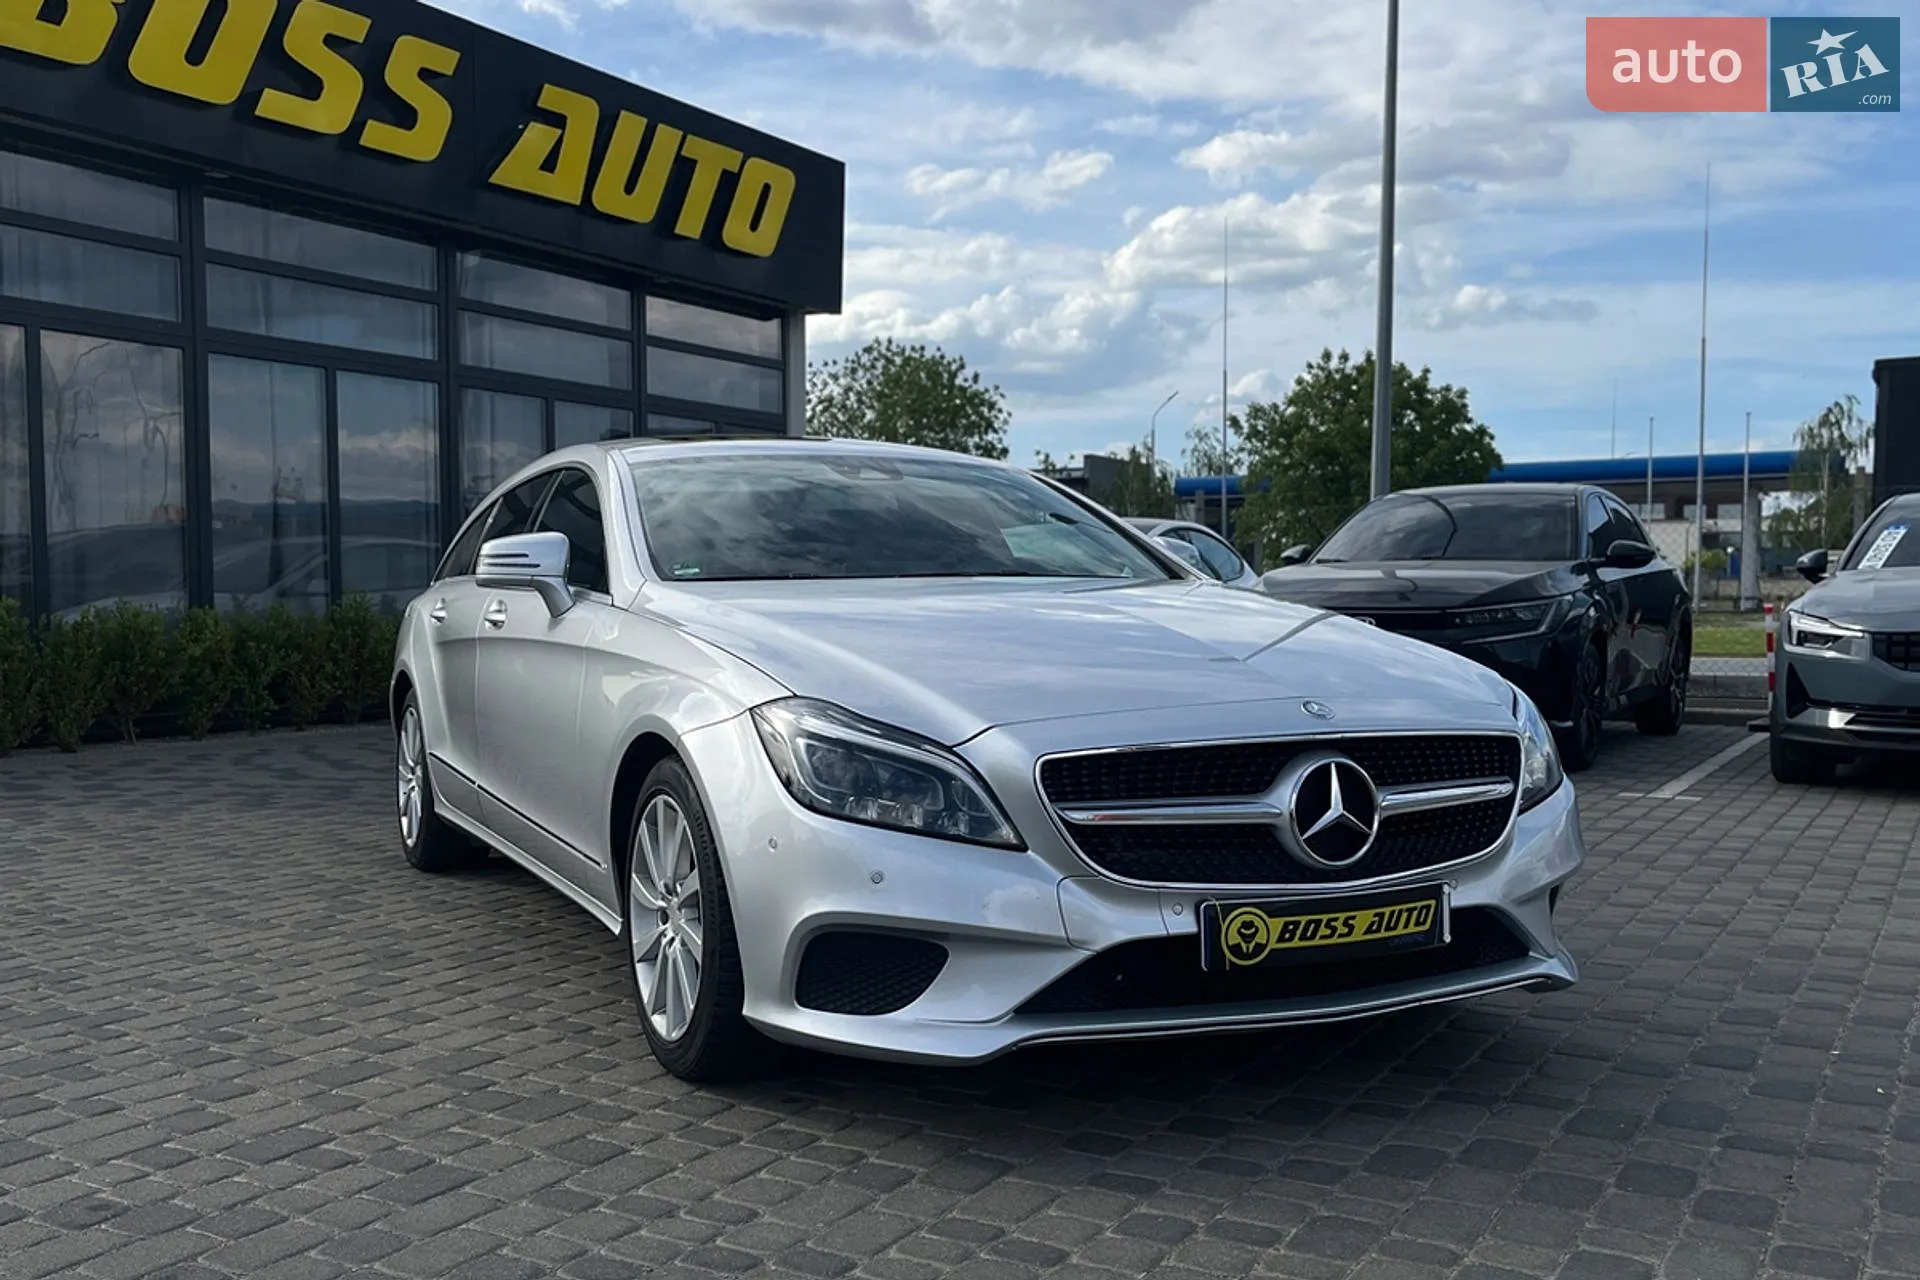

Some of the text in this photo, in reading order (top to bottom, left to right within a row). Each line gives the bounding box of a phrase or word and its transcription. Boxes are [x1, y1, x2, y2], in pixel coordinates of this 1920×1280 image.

[489, 84, 795, 257] AUTO
[1276, 916, 1356, 943] BOSS
[1363, 904, 1431, 935] AUTO
